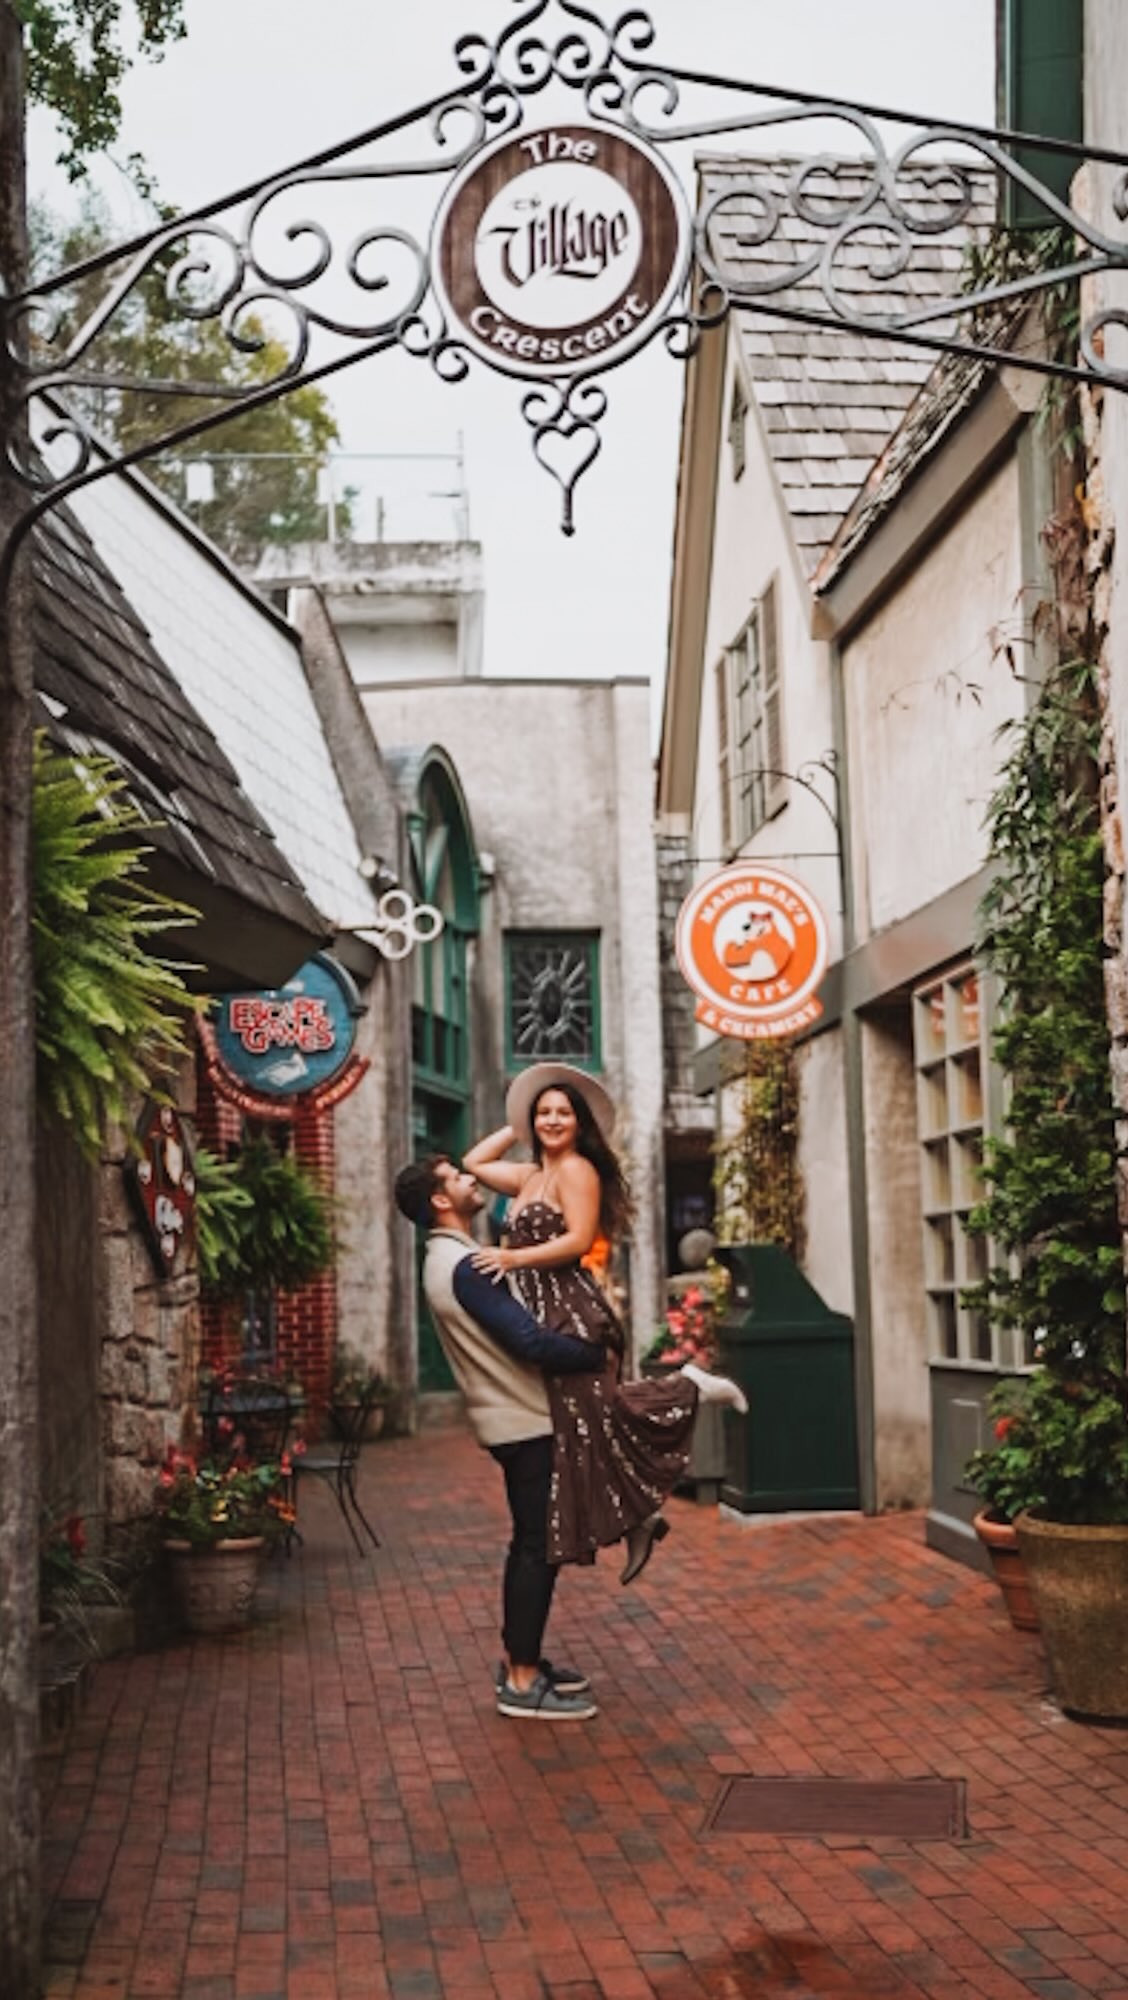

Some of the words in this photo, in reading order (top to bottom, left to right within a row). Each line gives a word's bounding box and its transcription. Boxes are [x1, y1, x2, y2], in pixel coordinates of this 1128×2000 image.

[520, 131, 598, 164] The
[486, 197, 629, 288] Village
[470, 293, 649, 361] Crescent
[699, 880, 753, 924] MADDI
[729, 978, 793, 1002] CAFE
[230, 996, 329, 1033] ESCAPE
[719, 1001, 818, 1038] CREAMERY
[241, 1015, 336, 1053] GAMES
